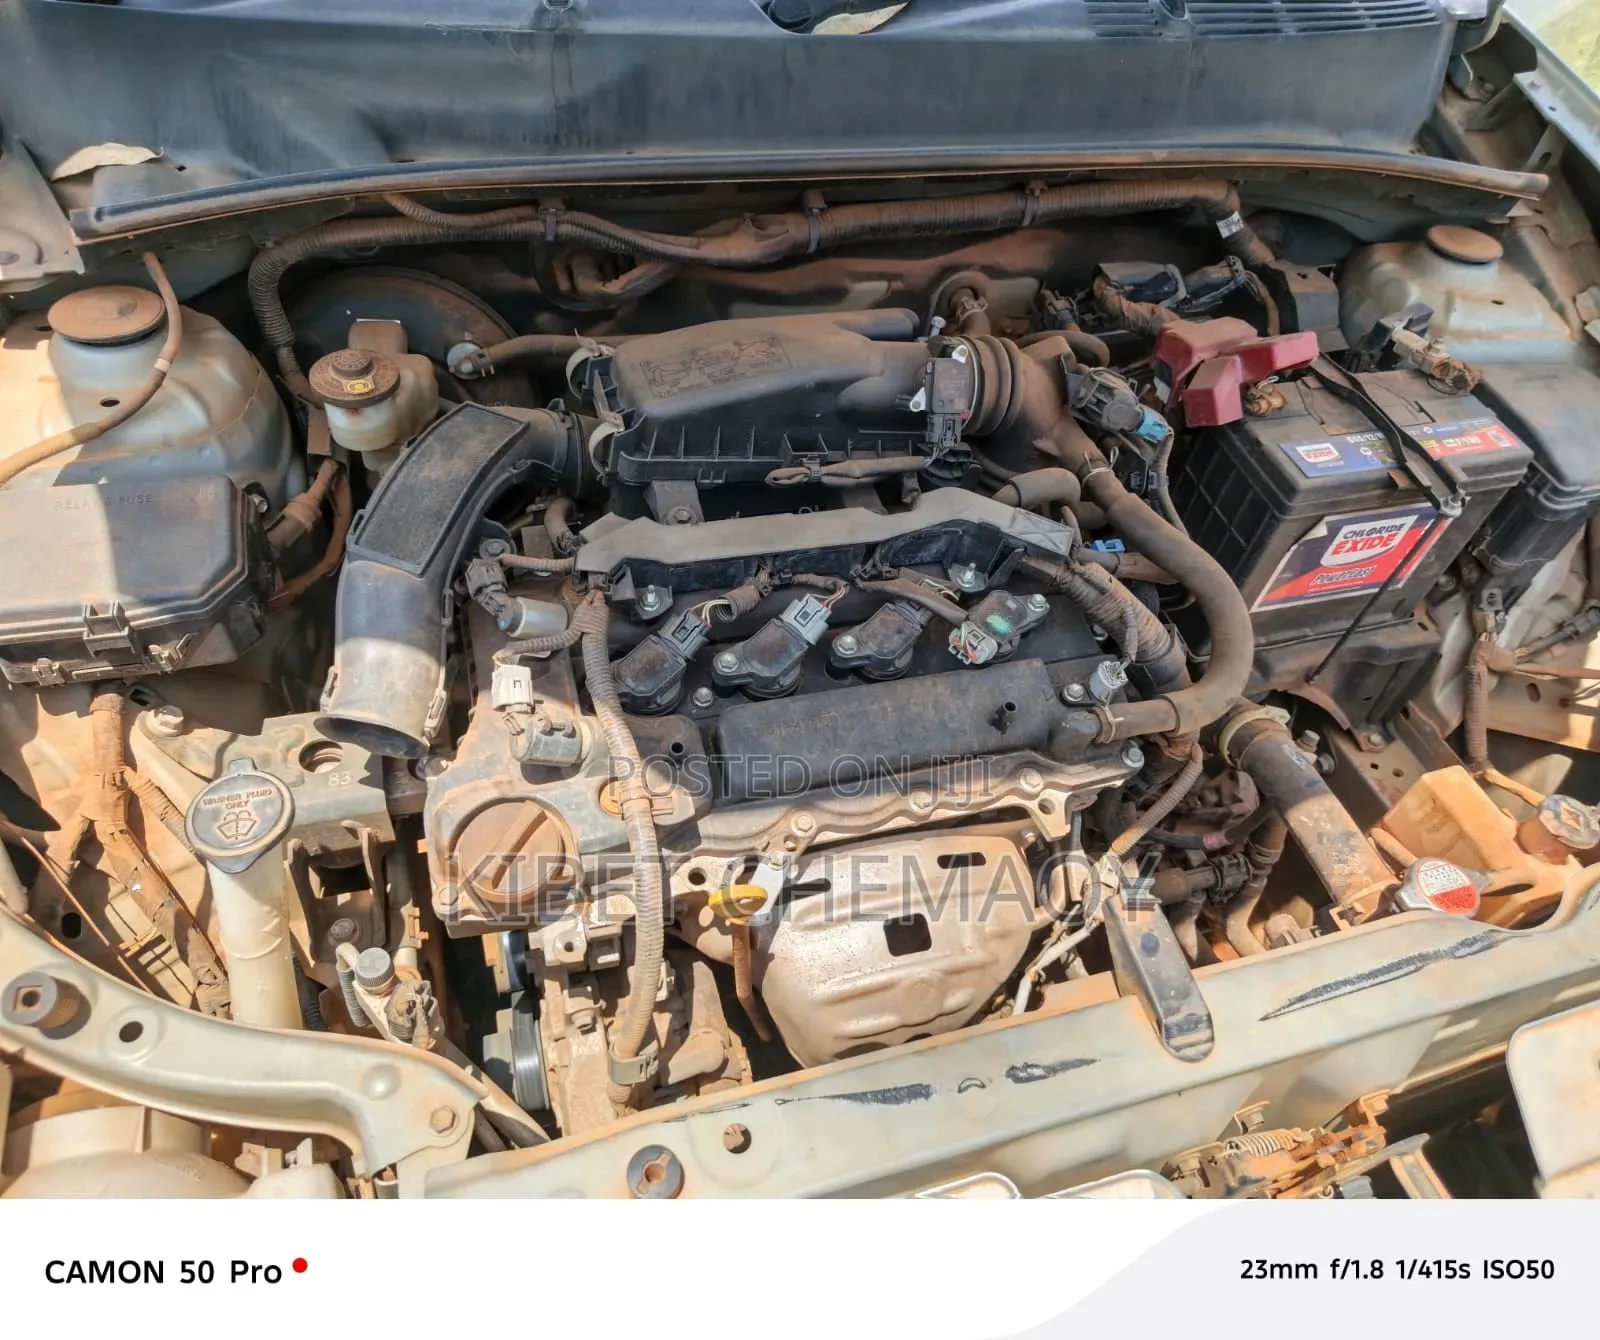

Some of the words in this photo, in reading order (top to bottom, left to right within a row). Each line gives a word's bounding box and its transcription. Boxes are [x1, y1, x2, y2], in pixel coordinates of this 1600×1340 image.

[119, 494, 154, 504] FUSE
[1344, 523, 1405, 537] CHLORIDE
[1331, 533, 1399, 556] EXIDE
[328, 770, 351, 786] 83
